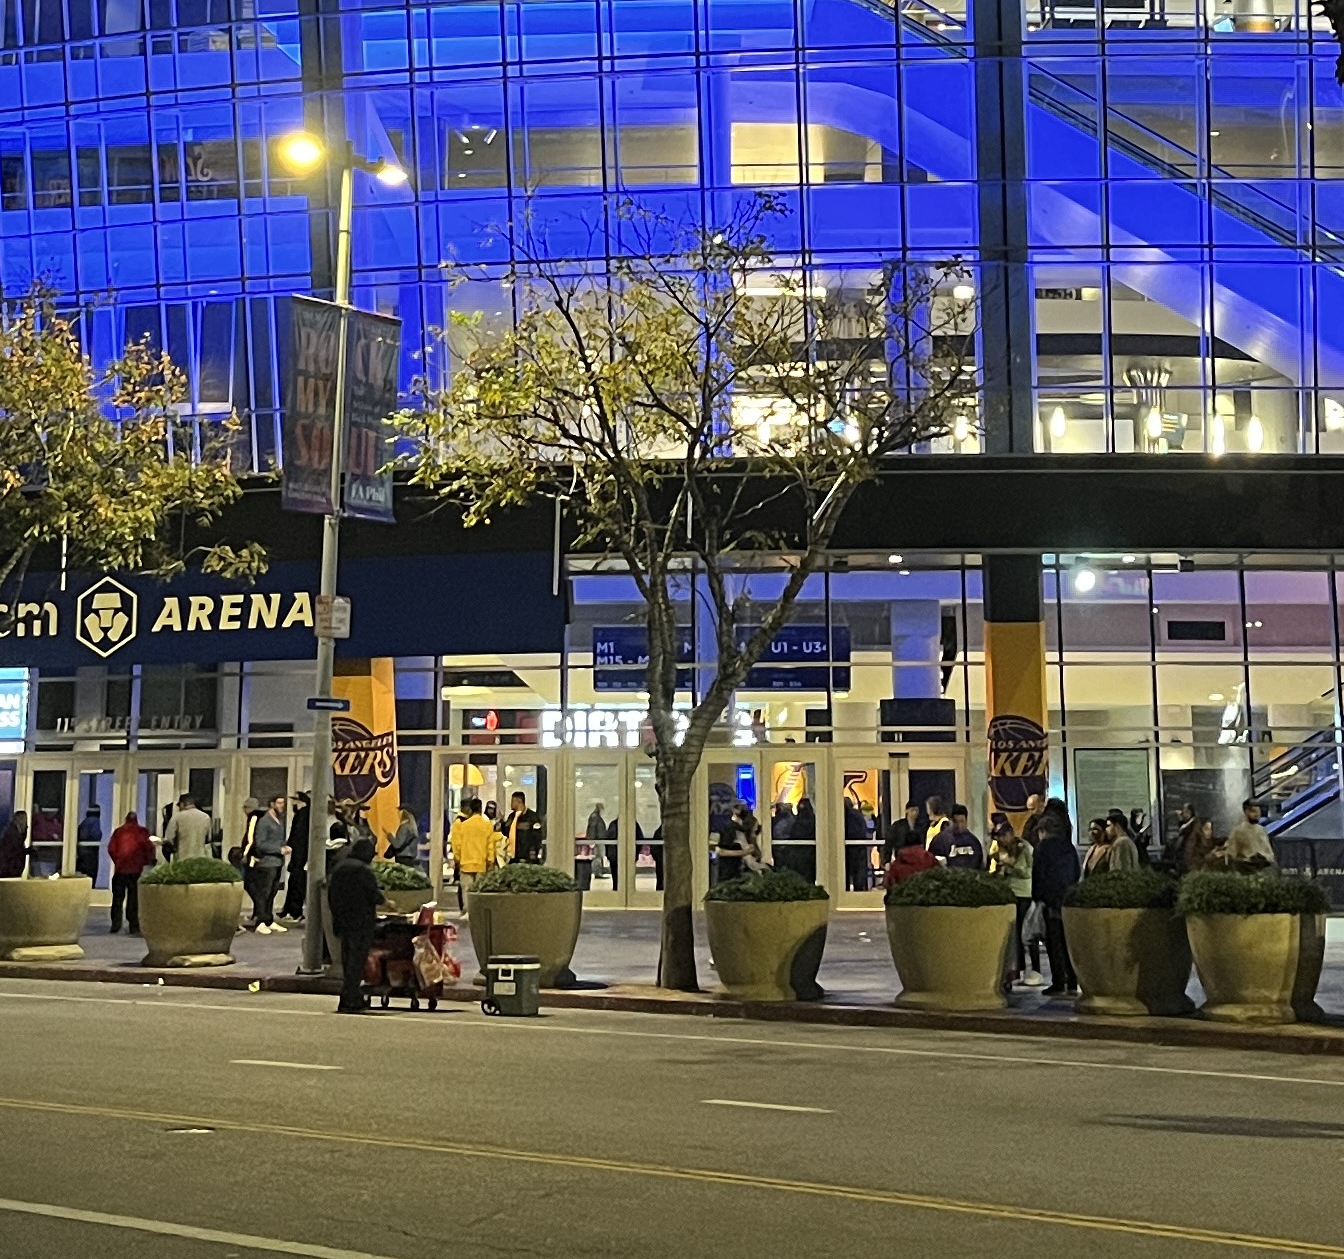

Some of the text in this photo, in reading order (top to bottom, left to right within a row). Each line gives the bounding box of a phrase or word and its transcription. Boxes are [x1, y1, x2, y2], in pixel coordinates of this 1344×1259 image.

[297, 375, 333, 416] MY
[151, 592, 314, 632] ARENA
[597, 642, 615, 654] M1
[771, 642, 788, 654] U1
[150, 715, 204, 732] ENTRY
[332, 746, 392, 783] KERS
